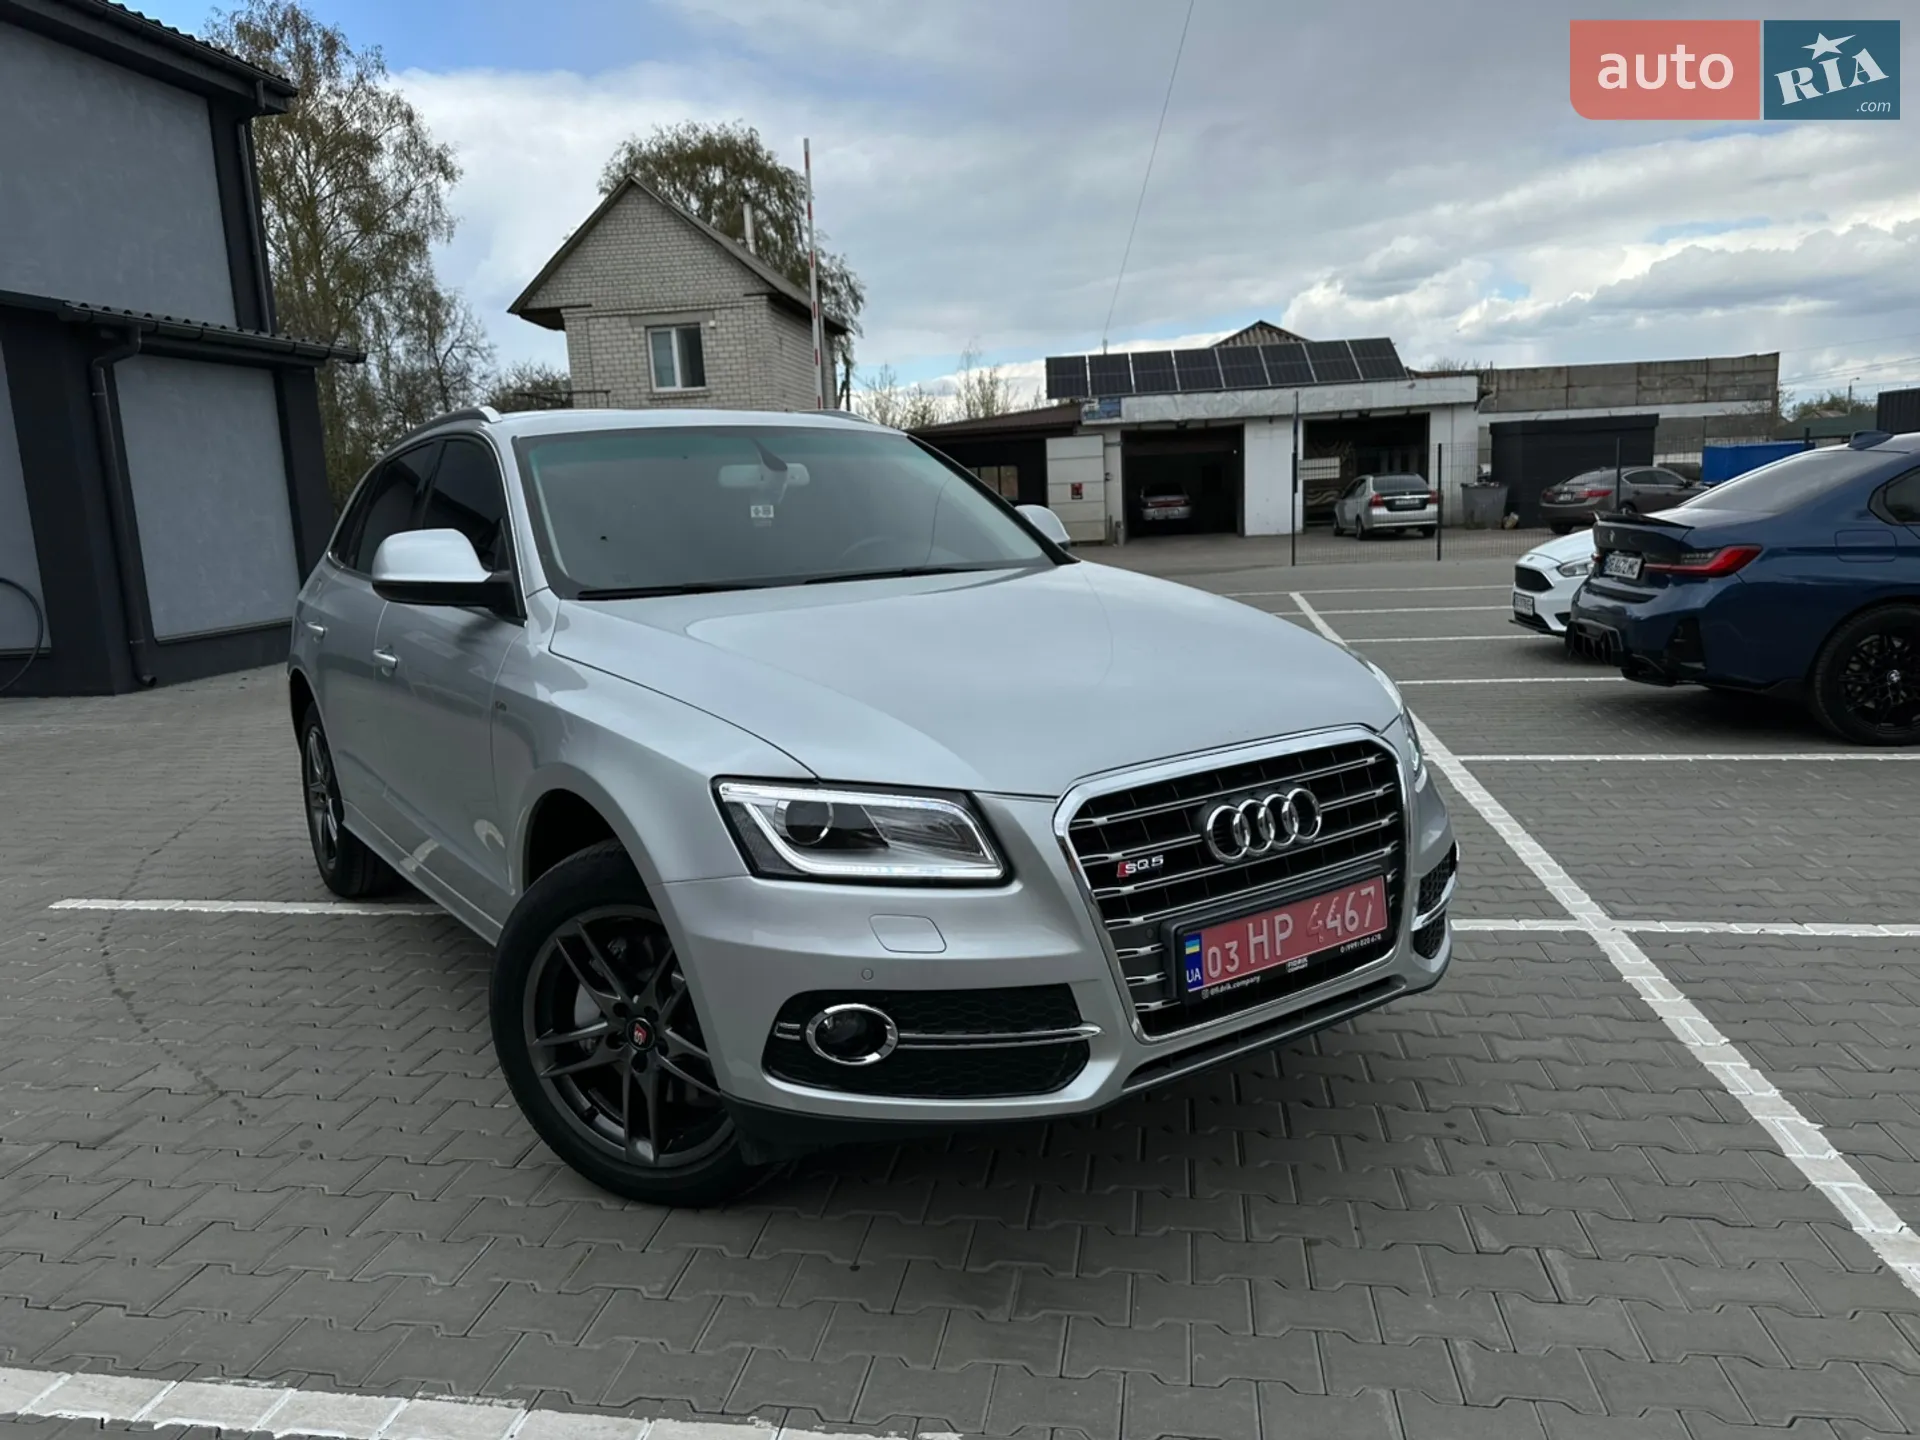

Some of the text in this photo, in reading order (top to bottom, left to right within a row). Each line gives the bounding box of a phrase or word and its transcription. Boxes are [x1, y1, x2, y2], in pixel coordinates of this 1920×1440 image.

[1122, 854, 1164, 874] SQ5
[1207, 885, 1376, 979] 03 HP 4467
[1186, 967, 1202, 983] UA
